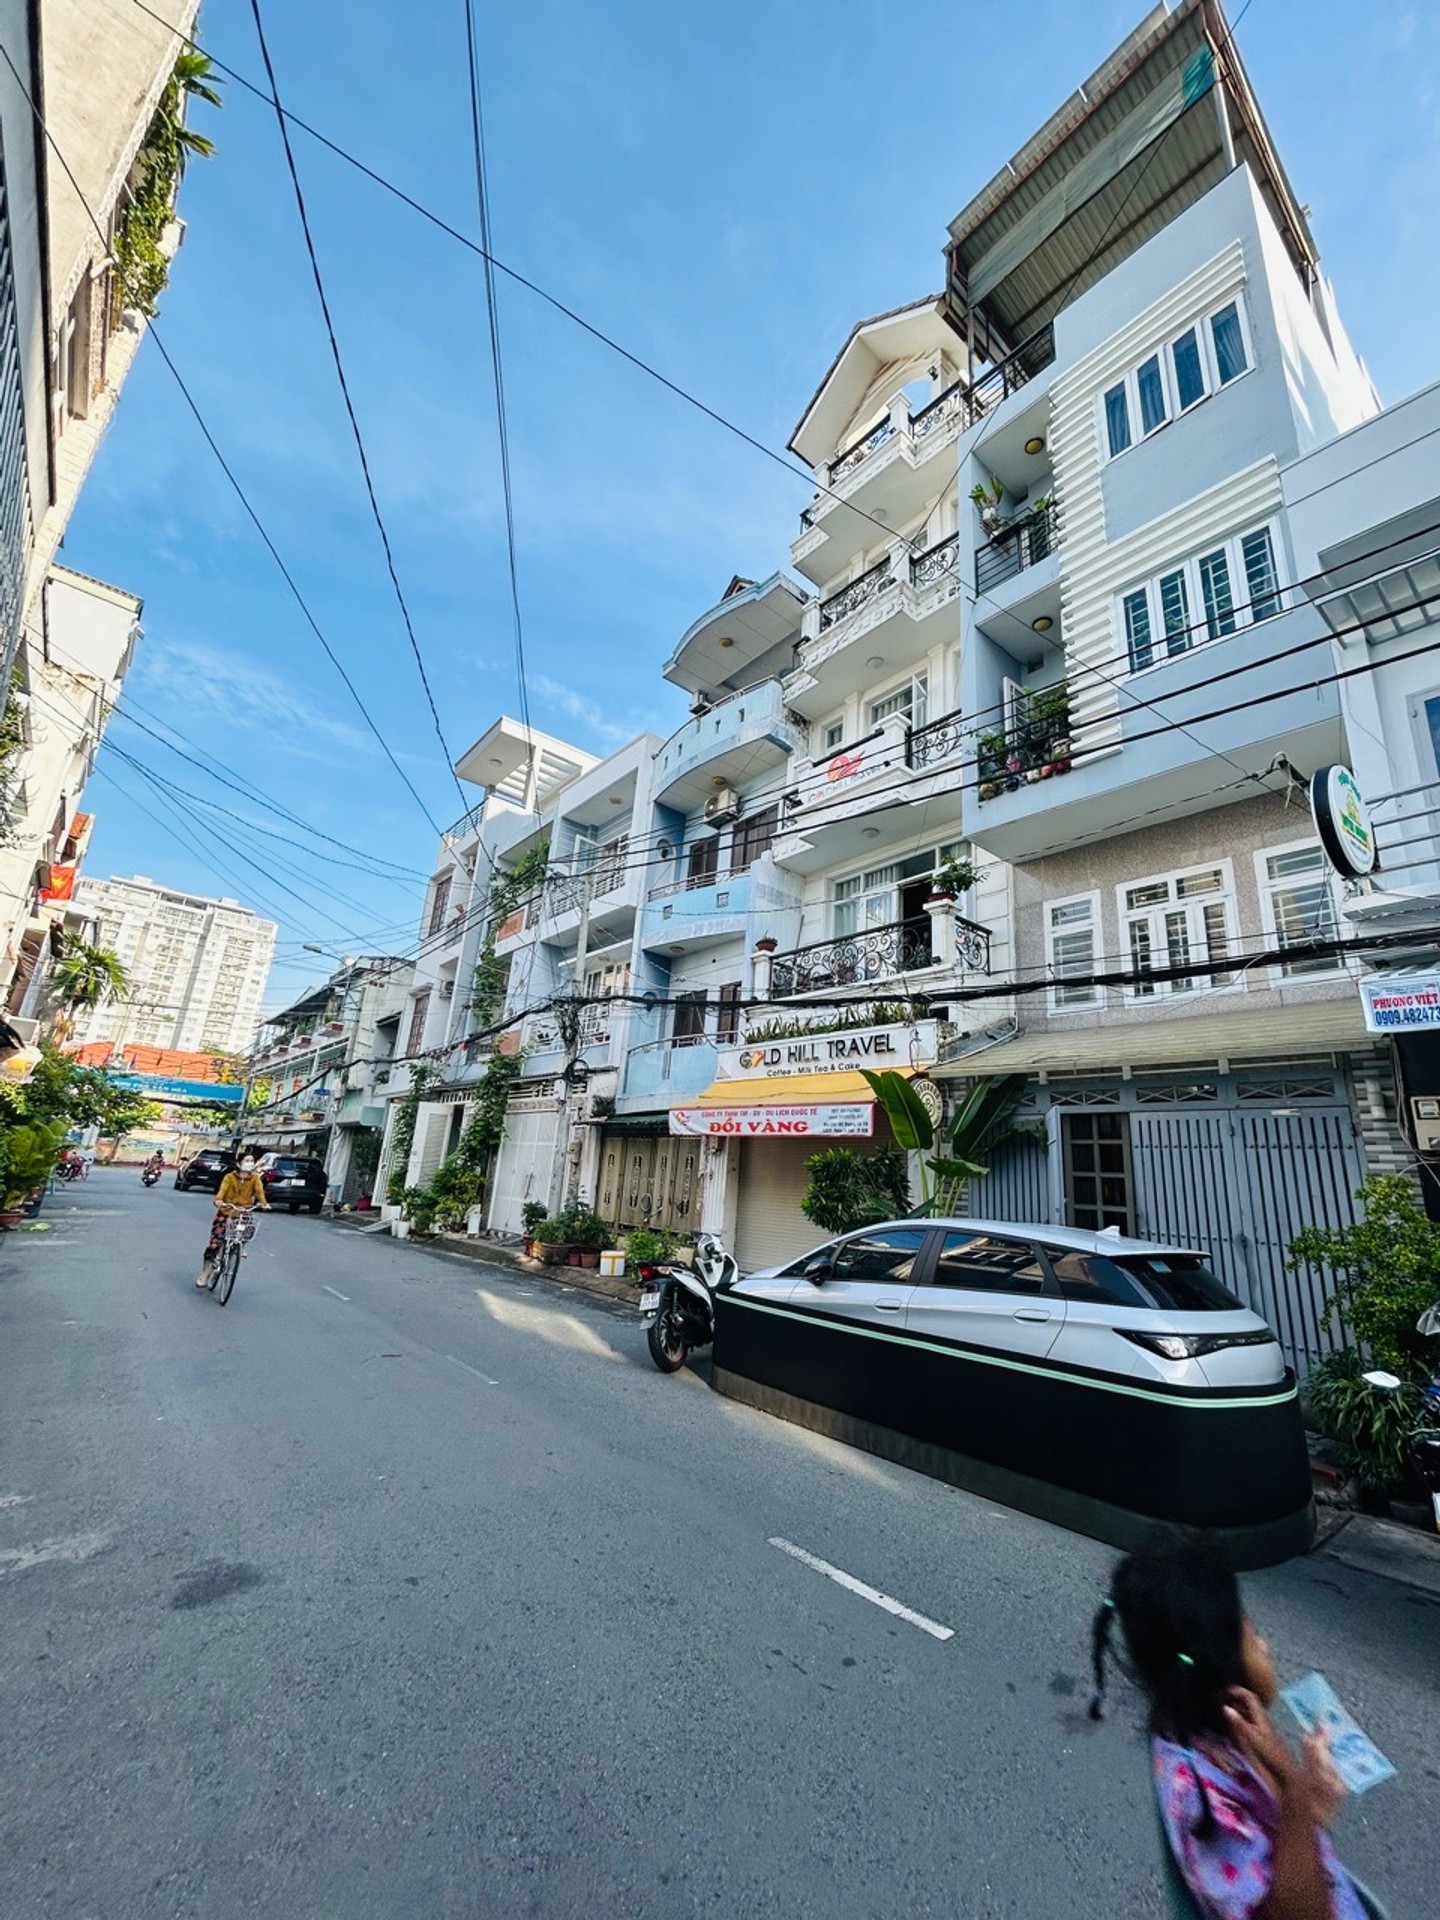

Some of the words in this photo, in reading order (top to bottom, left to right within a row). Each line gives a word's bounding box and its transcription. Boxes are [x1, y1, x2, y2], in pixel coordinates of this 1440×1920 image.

[788, 1043, 820, 1063] HILL
[827, 1033, 895, 1058] TRAVEL
[766, 1069, 792, 1077] Coffee
[798, 1066, 812, 1074] Milk
[830, 1063, 836, 1071] &
[838, 1062, 861, 1071] Cake
[747, 1118, 808, 1132] VÀNG
